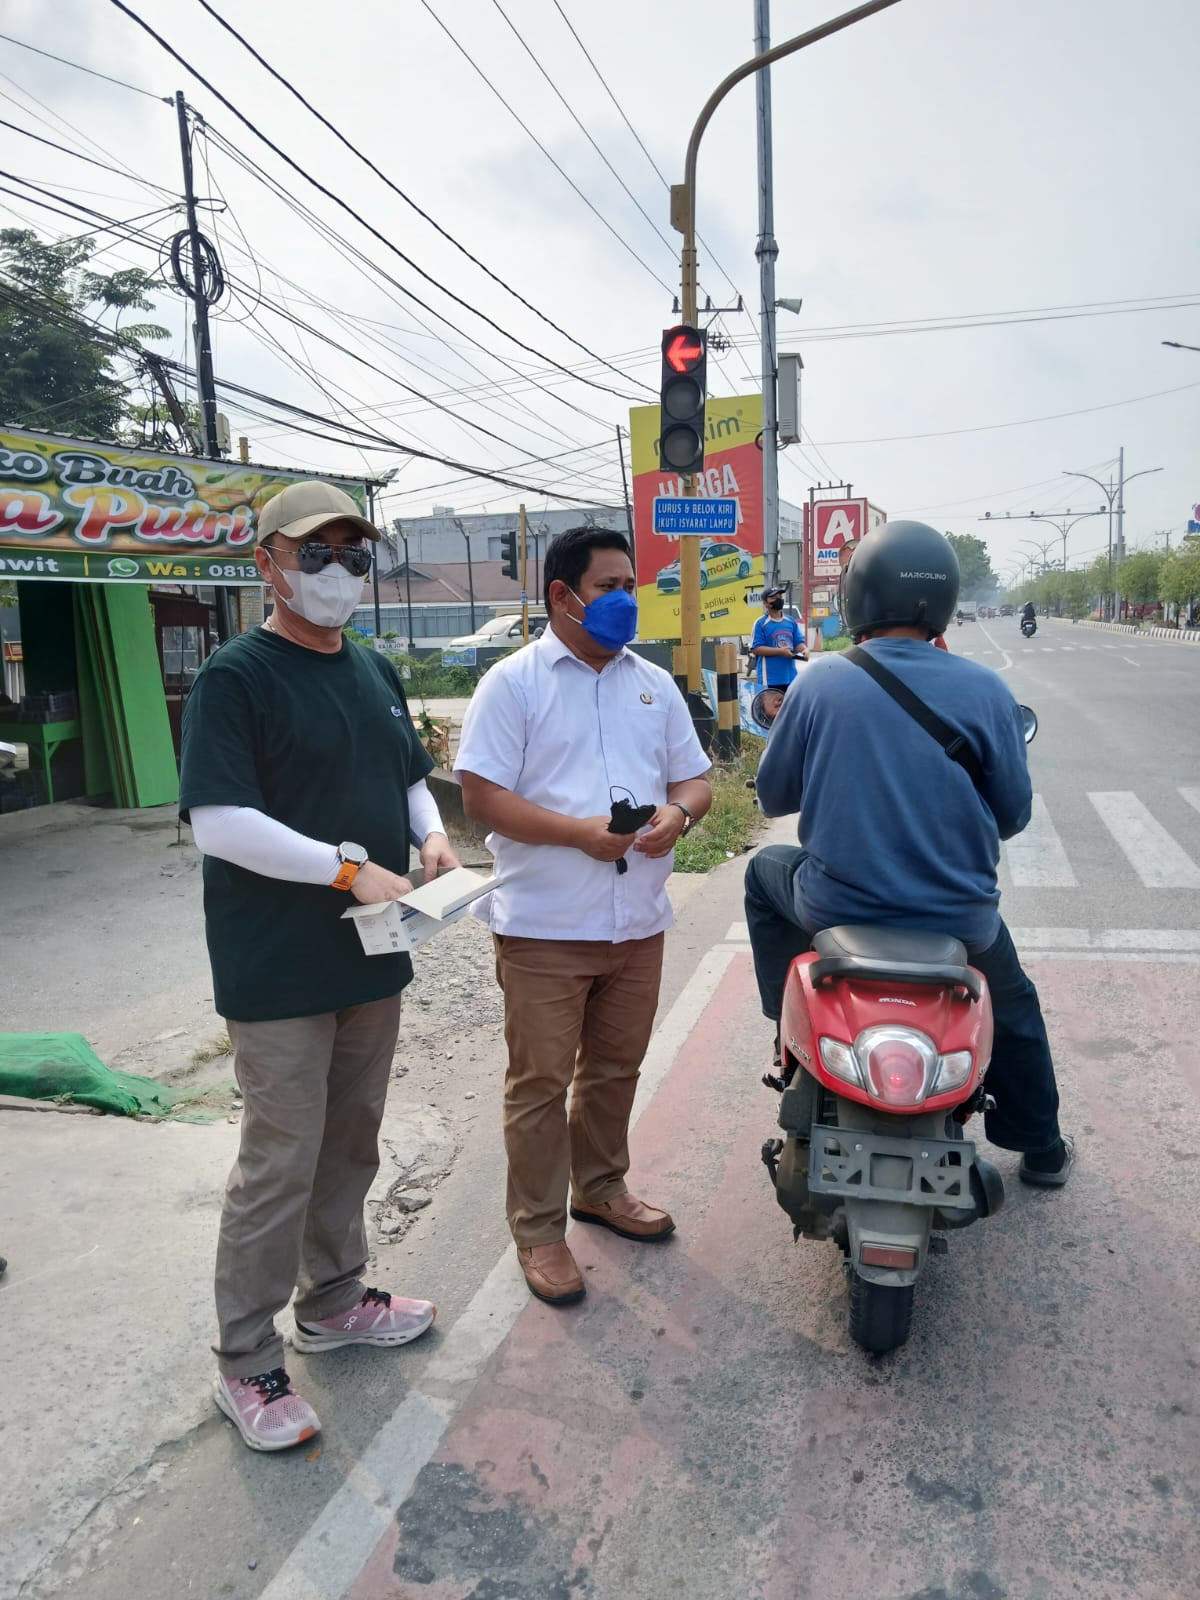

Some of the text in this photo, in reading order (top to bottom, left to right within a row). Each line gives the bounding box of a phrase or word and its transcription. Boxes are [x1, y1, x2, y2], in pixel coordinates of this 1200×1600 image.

[56, 453, 194, 497] Buah
[659, 464, 740, 498] HRGA
[64, 487, 253, 544] Putri
[658, 503, 733, 514] LURUS & BELOK KIRI
[658, 517, 733, 529] IKUTI ISYARAT LAMPU
[146, 562, 187, 577] Wa
[900, 571, 947, 581] MARCOLINO
[704, 592, 736, 609] aplikasi
